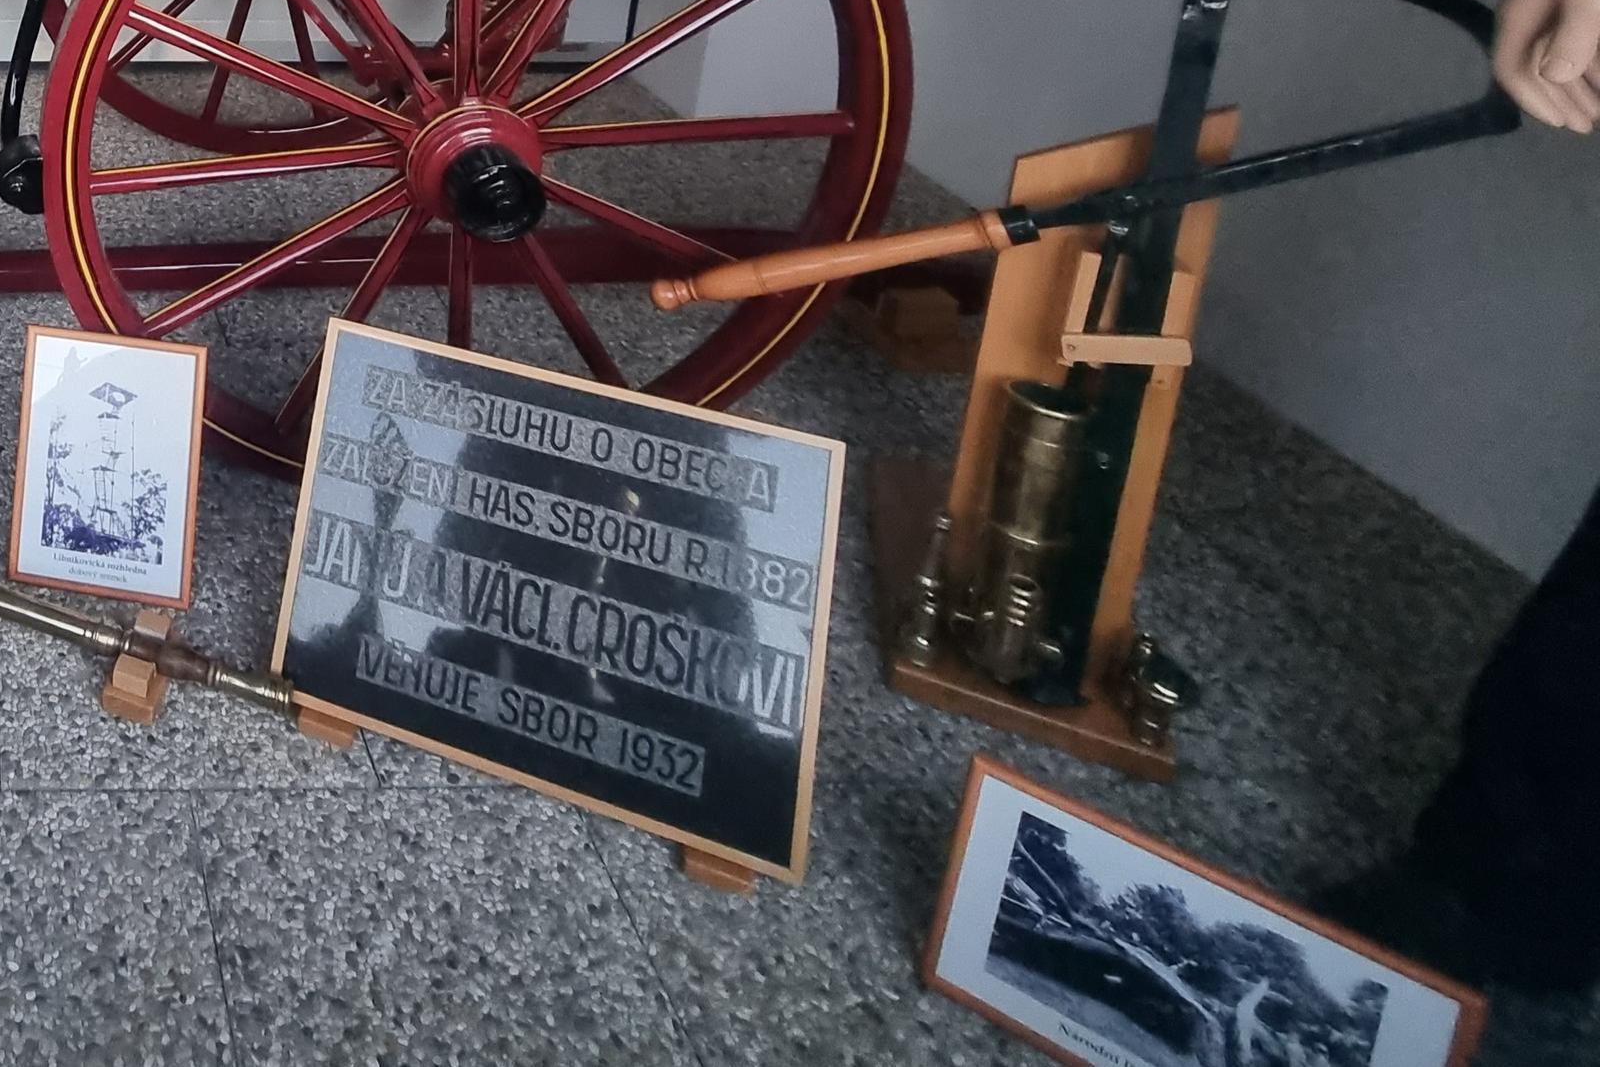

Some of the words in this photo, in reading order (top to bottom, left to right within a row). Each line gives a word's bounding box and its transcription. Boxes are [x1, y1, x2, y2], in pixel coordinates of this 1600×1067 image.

[591, 427, 614, 463] O
[631, 436, 728, 491] OBEC
[749, 465, 773, 507] A
[467, 477, 541, 532] HAS.
[547, 501, 673, 566] SBORU
[460, 556, 562, 651] VÁCL.
[497, 686, 599, 754] SBOR
[617, 728, 701, 789] 1932
